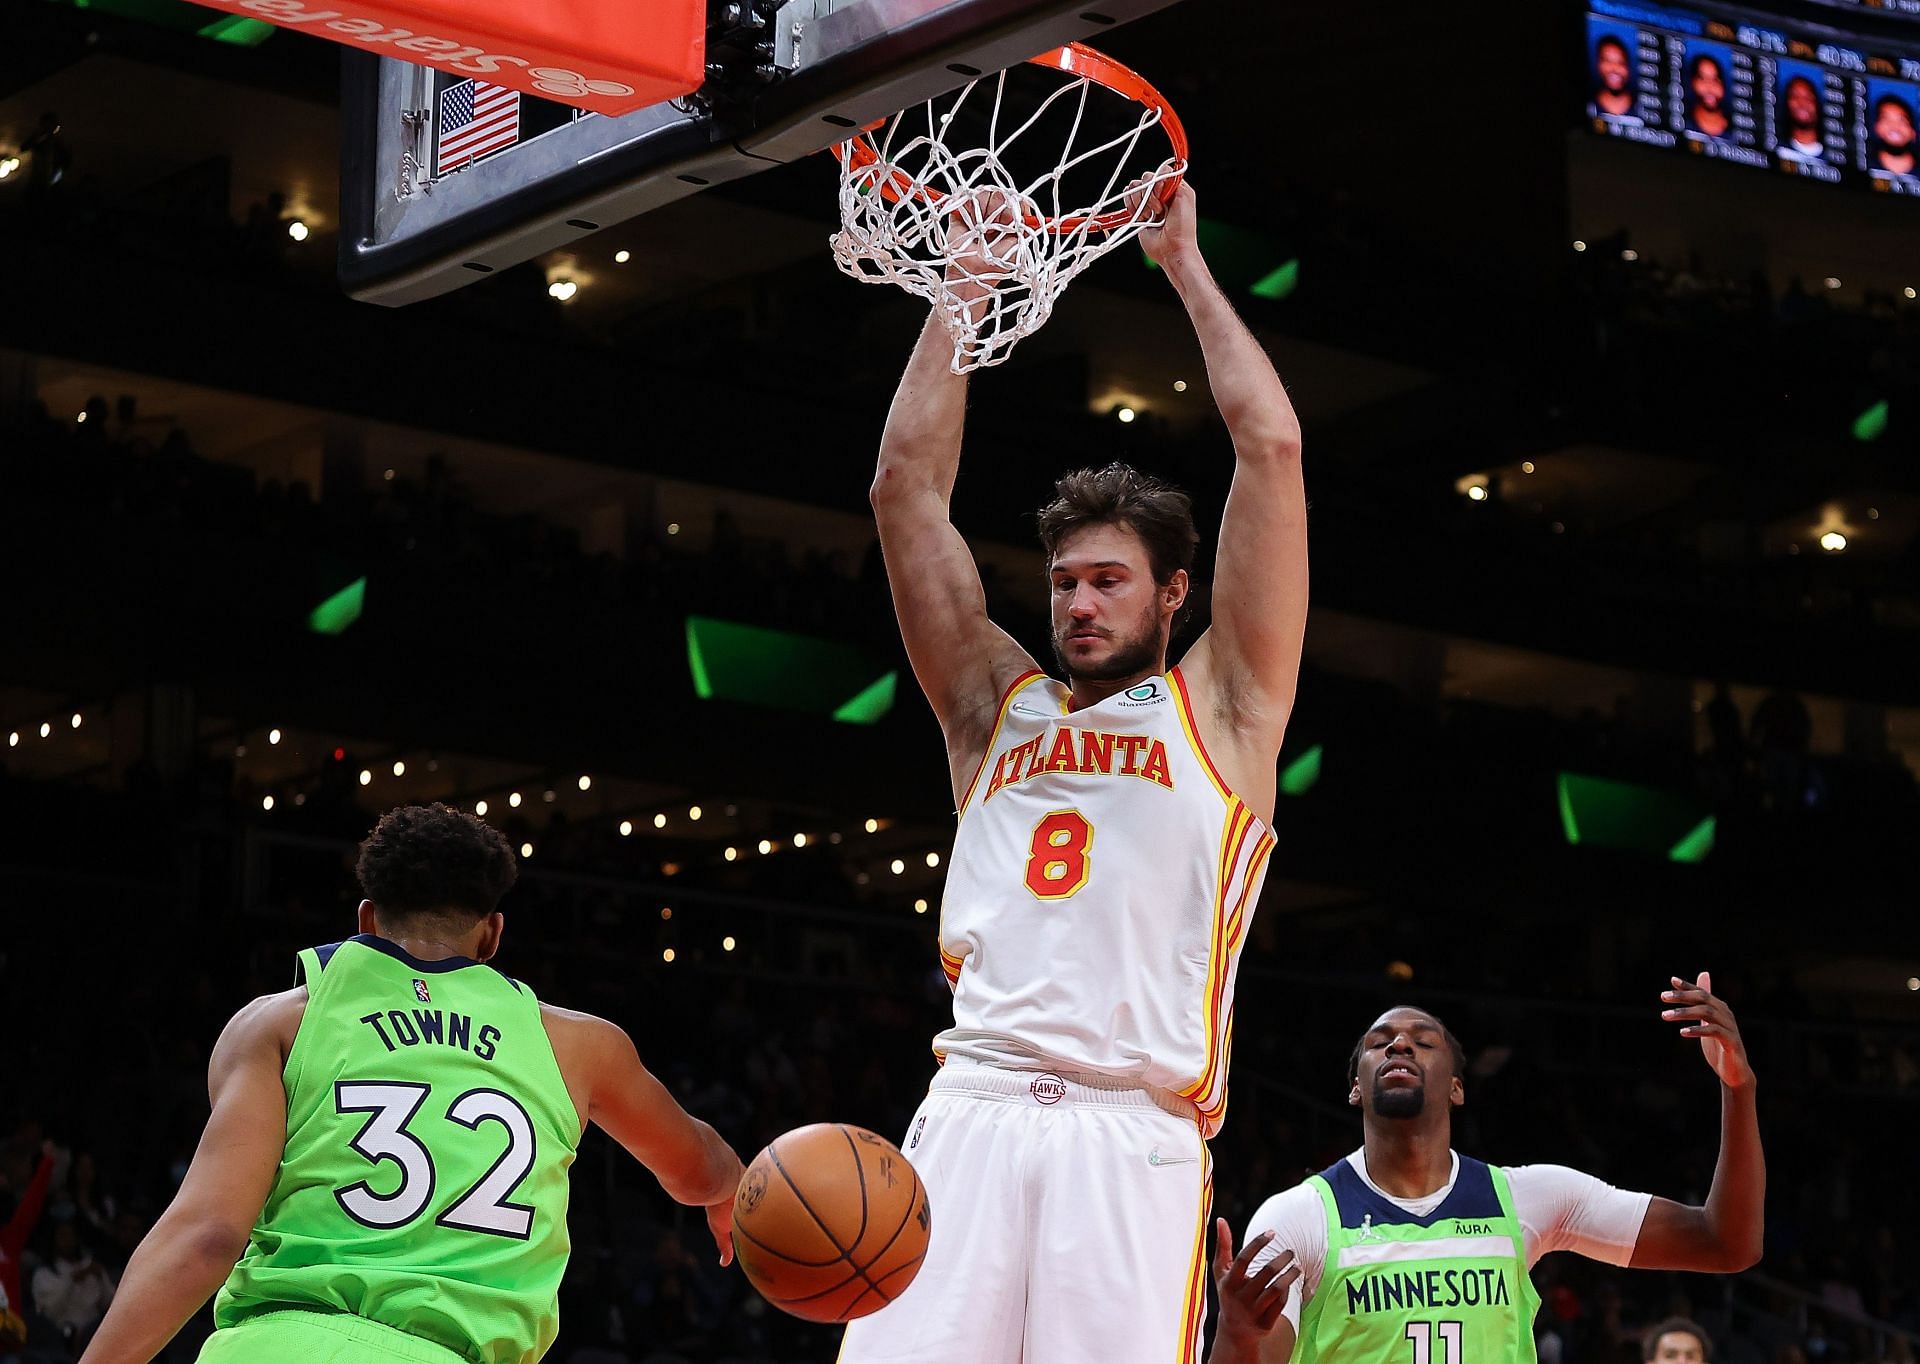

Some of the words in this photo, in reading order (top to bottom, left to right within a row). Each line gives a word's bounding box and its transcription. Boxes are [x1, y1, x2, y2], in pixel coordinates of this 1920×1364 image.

[1117, 696, 1167, 708] sharecare
[983, 726, 1175, 806] ATLANTA
[1023, 808, 1095, 901] 8
[359, 1008, 502, 1061] TOWNS
[1029, 1081, 1067, 1096] HAWKS
[333, 1080, 537, 1241] 32
[1345, 1268, 1510, 1315] MINNESOTA
[1404, 1320, 1464, 1364] 11
